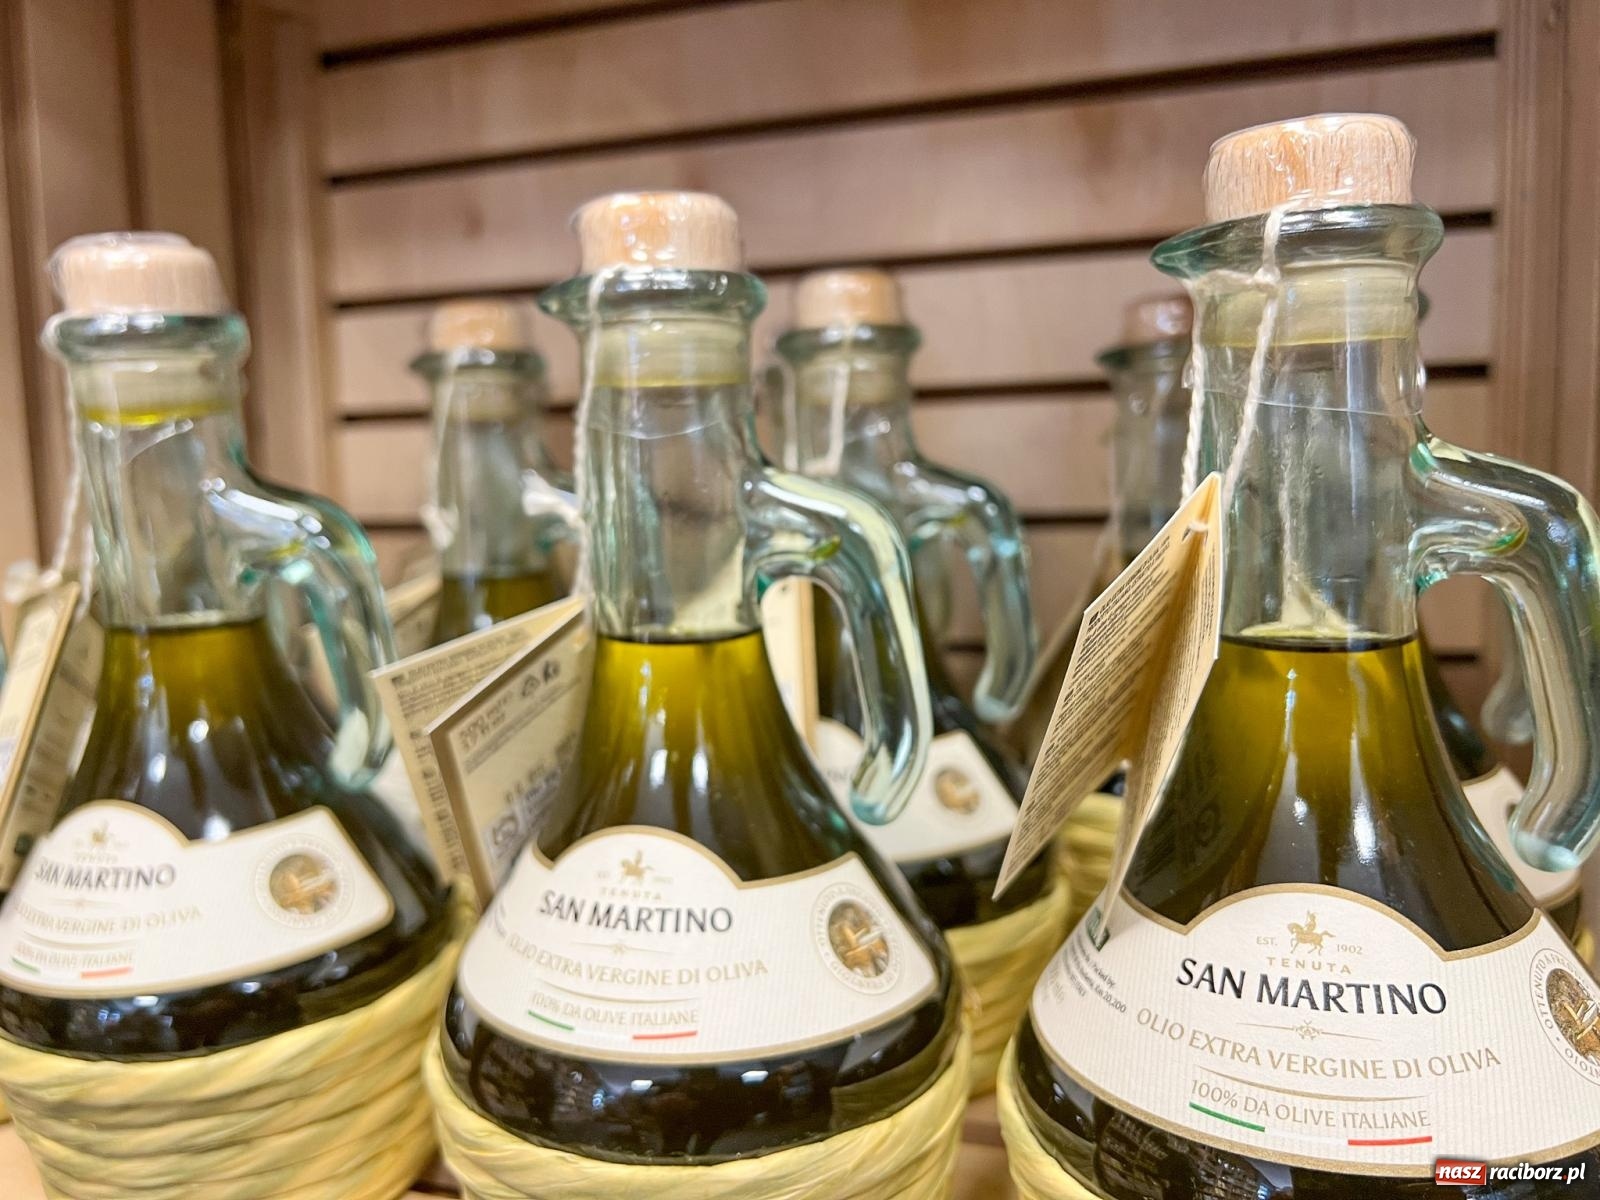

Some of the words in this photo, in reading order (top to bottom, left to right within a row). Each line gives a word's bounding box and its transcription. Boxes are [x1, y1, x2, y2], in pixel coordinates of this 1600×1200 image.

[34, 856, 64, 884] SAN
[64, 863, 177, 891] MARTINO
[539, 890, 585, 923] SAN
[588, 901, 733, 933] MARTINO
[1256, 936, 1278, 946] EST.
[1336, 944, 1363, 955] 1902
[536, 950, 582, 977] EXTRA
[588, 963, 673, 987] VERGINE
[677, 967, 700, 985] DI
[705, 959, 769, 984] OLIVA
[1266, 956, 1352, 974] TENUTA
[1176, 958, 1247, 999] SAN
[1256, 974, 1447, 1015] MARTINO
[630, 1010, 699, 1027] ITALIANE
[1137, 1008, 1185, 1041] OLIO
[1189, 1029, 1261, 1066] EXTRA
[1267, 1050, 1387, 1079] VERGINE
[1392, 1058, 1423, 1079] DI
[1428, 1048, 1501, 1077] OLIVA
[1191, 1080, 1238, 1109] 100%
[1244, 1096, 1270, 1117] DA
[1275, 1104, 1337, 1128] OLIVE
[1342, 1110, 1432, 1129] ITALIANE
